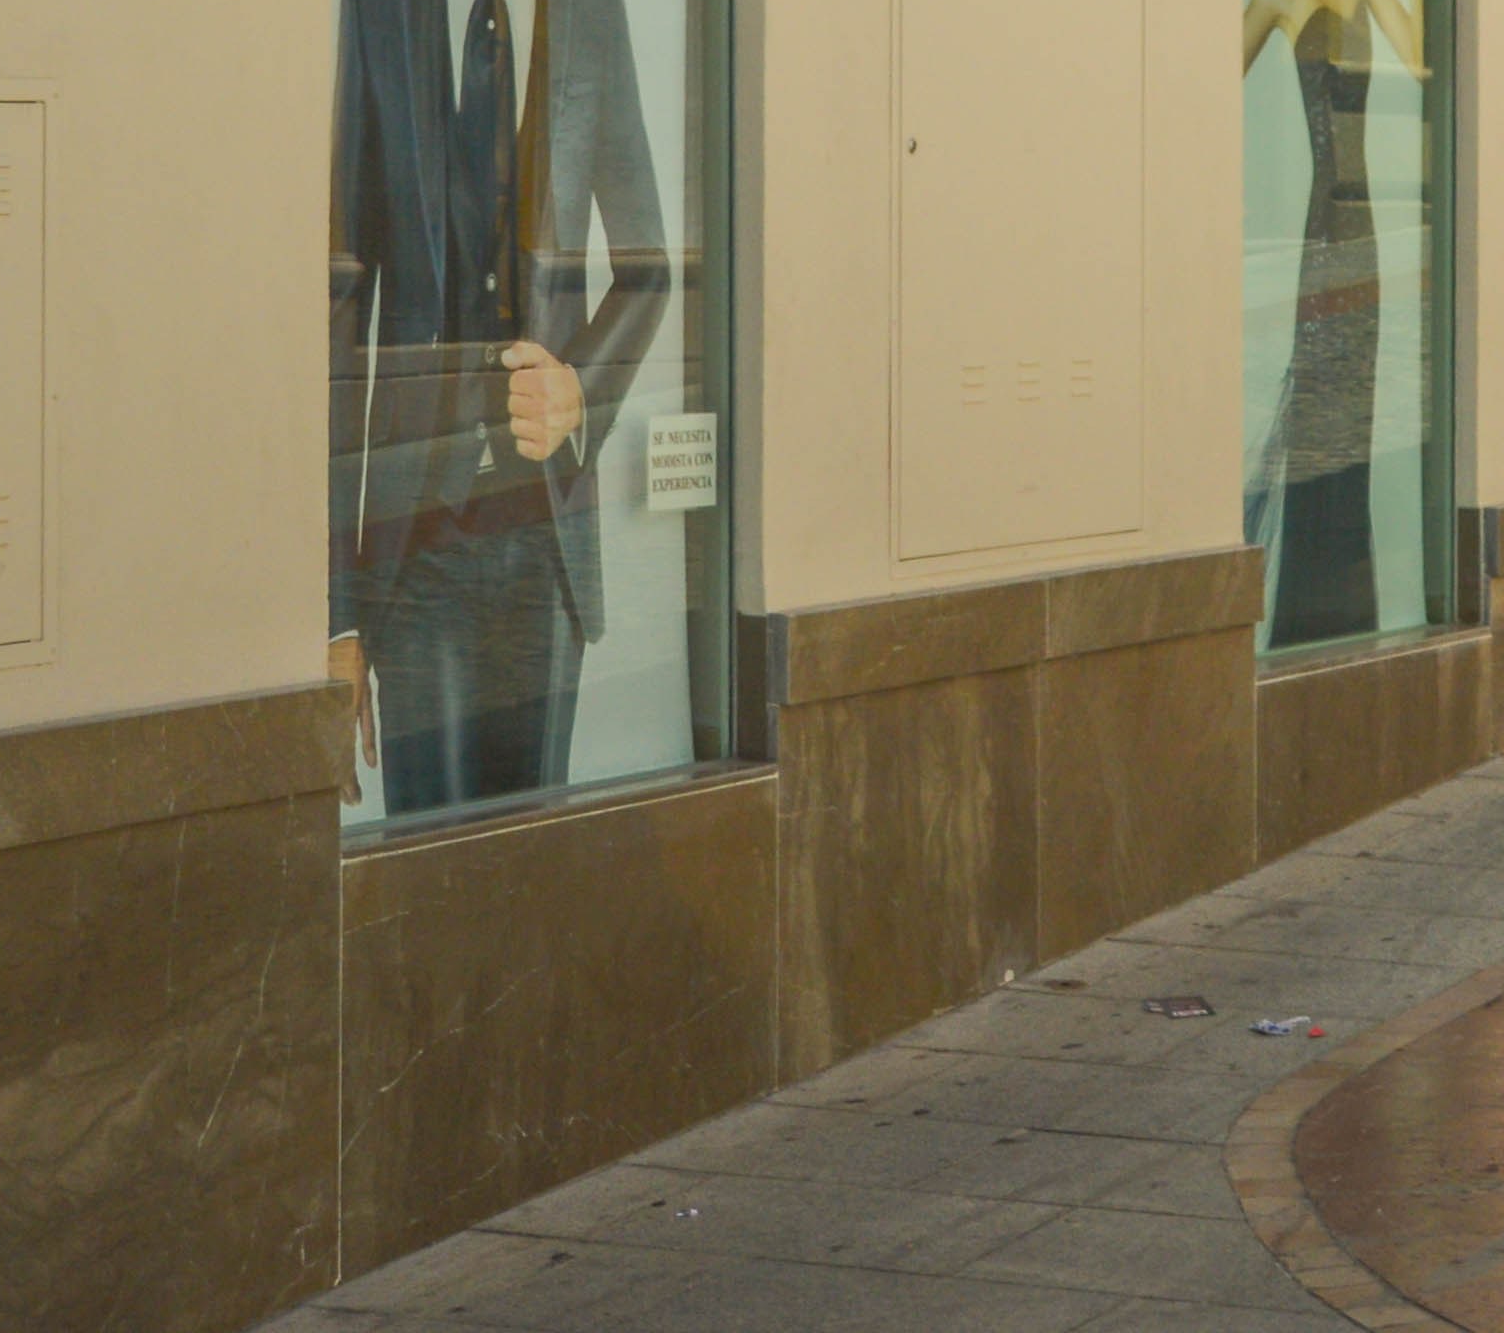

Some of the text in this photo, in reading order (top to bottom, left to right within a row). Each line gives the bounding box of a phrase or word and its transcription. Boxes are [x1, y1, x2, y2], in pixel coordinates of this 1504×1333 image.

[653, 429, 712, 445] SE NECESITA
[694, 452, 714, 466] CON
[652, 476, 712, 493] EXPERIENCIA
